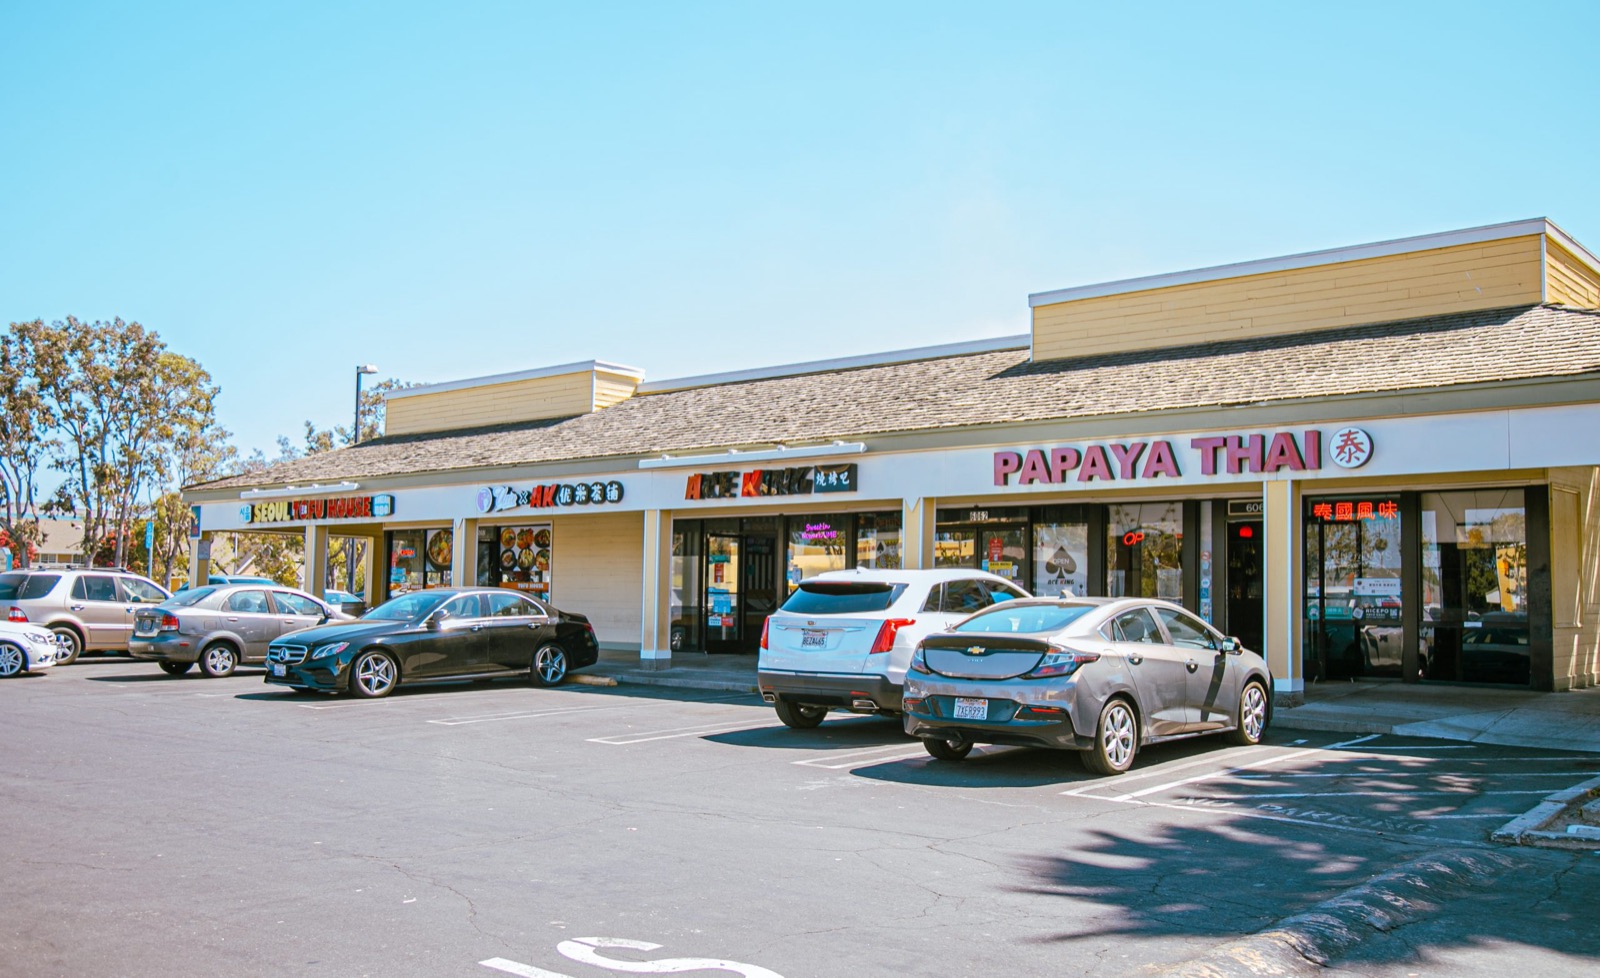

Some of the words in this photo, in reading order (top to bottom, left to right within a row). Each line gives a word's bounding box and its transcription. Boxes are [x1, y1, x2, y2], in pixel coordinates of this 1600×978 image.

[993, 440, 1182, 486] PAPAYA
[1190, 430, 1322, 476] THAI
[1334, 429, 1365, 464] 泰
[253, 501, 291, 523] SEOUL
[293, 498, 325, 520] TOFU
[327, 495, 372, 518] HOUSE
[529, 483, 558, 508] AK
[1313, 500, 1398, 521] 泰國風味
